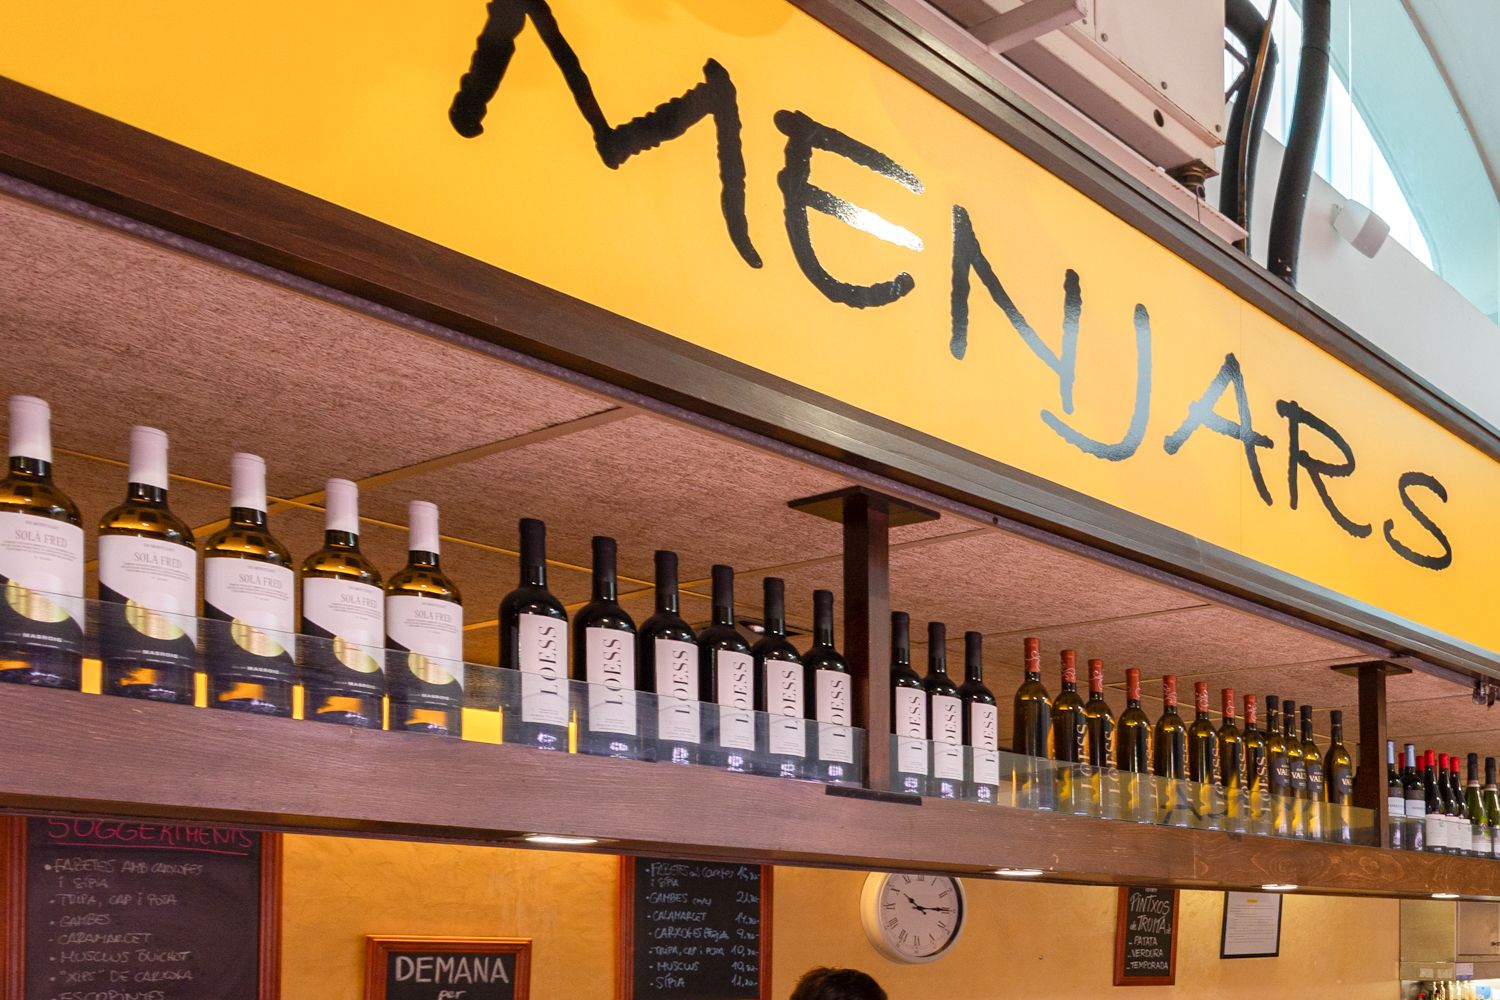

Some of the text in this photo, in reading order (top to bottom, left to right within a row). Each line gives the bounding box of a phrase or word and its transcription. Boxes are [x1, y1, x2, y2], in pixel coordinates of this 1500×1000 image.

[448, 0, 1452, 571] MENJARS
[537, 625, 558, 695] LOESS
[602, 638, 623, 705] LOESS
[672, 650, 690, 714] LOESS
[733, 662, 749, 723] LOESS
[782, 670, 798, 730] LOESS
[831, 680, 846, 737] LOESS
[908, 696, 922, 750] LOESS
[1130, 892, 1170, 915] PINTXOS
[1130, 961, 1168, 970] TEMPORADA
[1131, 948, 1164, 958] VERDURA
[1134, 935, 1158, 946] PATATA
[395, 955, 510, 985] DEMANA
